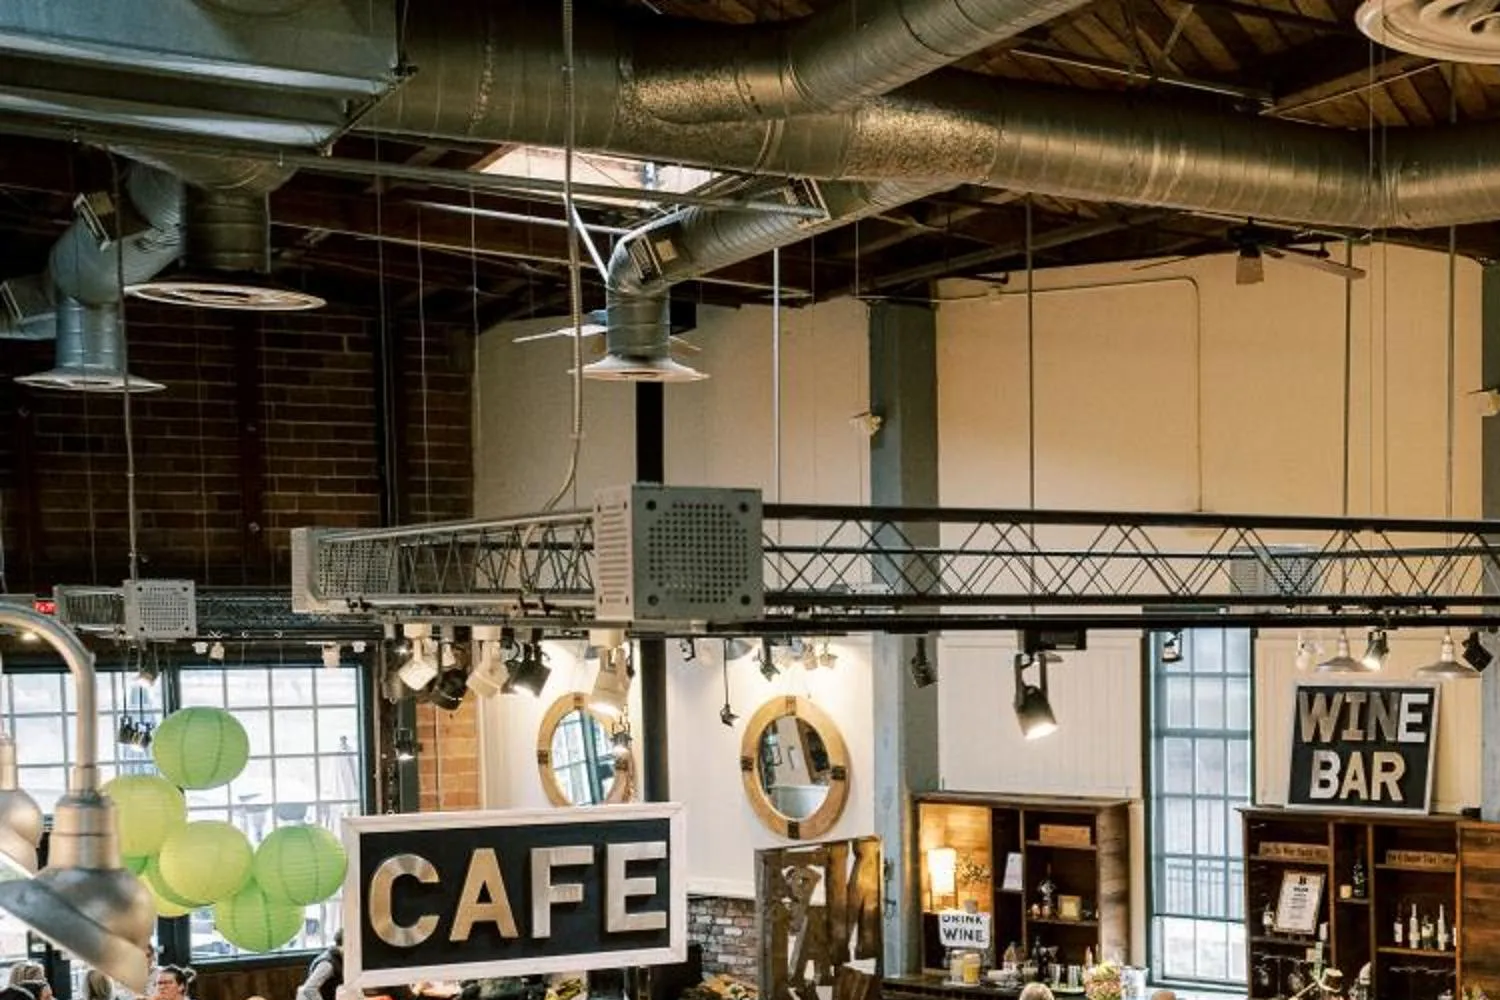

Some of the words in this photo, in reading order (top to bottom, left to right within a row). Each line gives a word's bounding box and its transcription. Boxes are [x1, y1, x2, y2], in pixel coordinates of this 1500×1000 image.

[1299, 691, 1430, 744] WINE
[1309, 750, 1405, 802] BAR
[369, 841, 668, 947] CAFE
[943, 928, 984, 943] WINE
